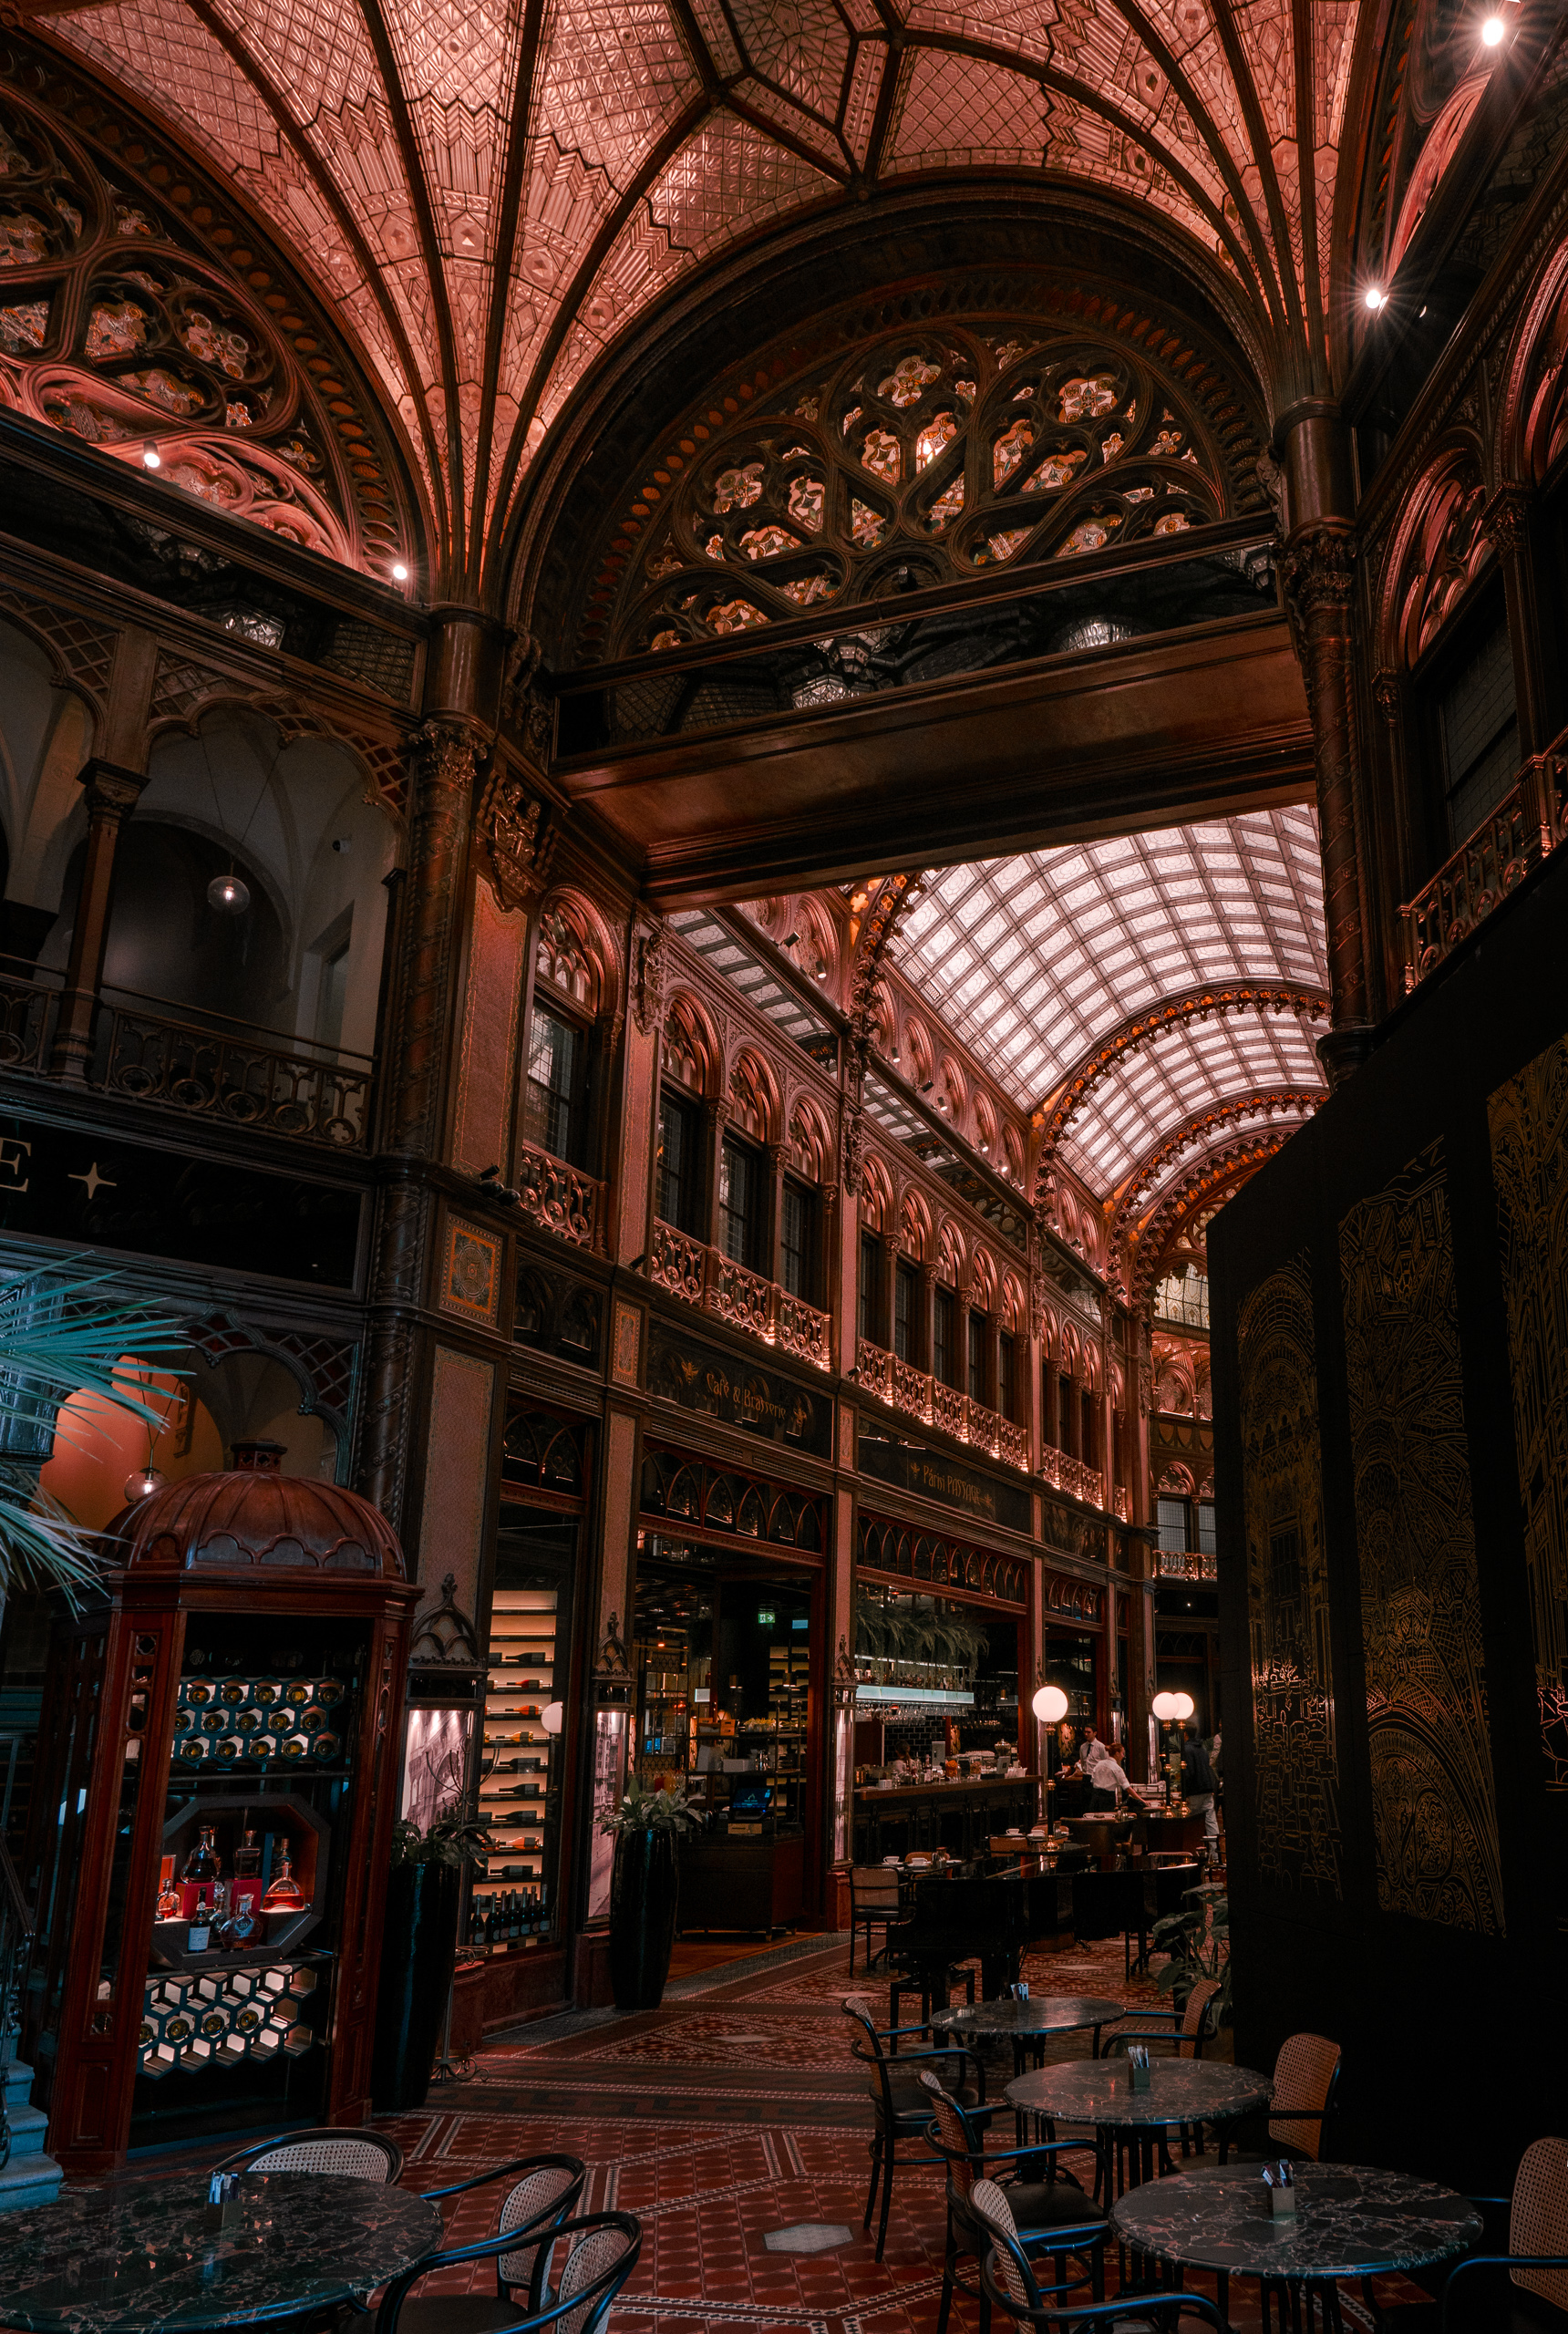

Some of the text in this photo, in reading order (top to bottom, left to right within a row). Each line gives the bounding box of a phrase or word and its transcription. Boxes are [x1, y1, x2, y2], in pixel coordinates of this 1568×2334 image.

[707, 1372, 786, 1420] Café & Brasserie
[923, 1464, 945, 1492] Párisi
